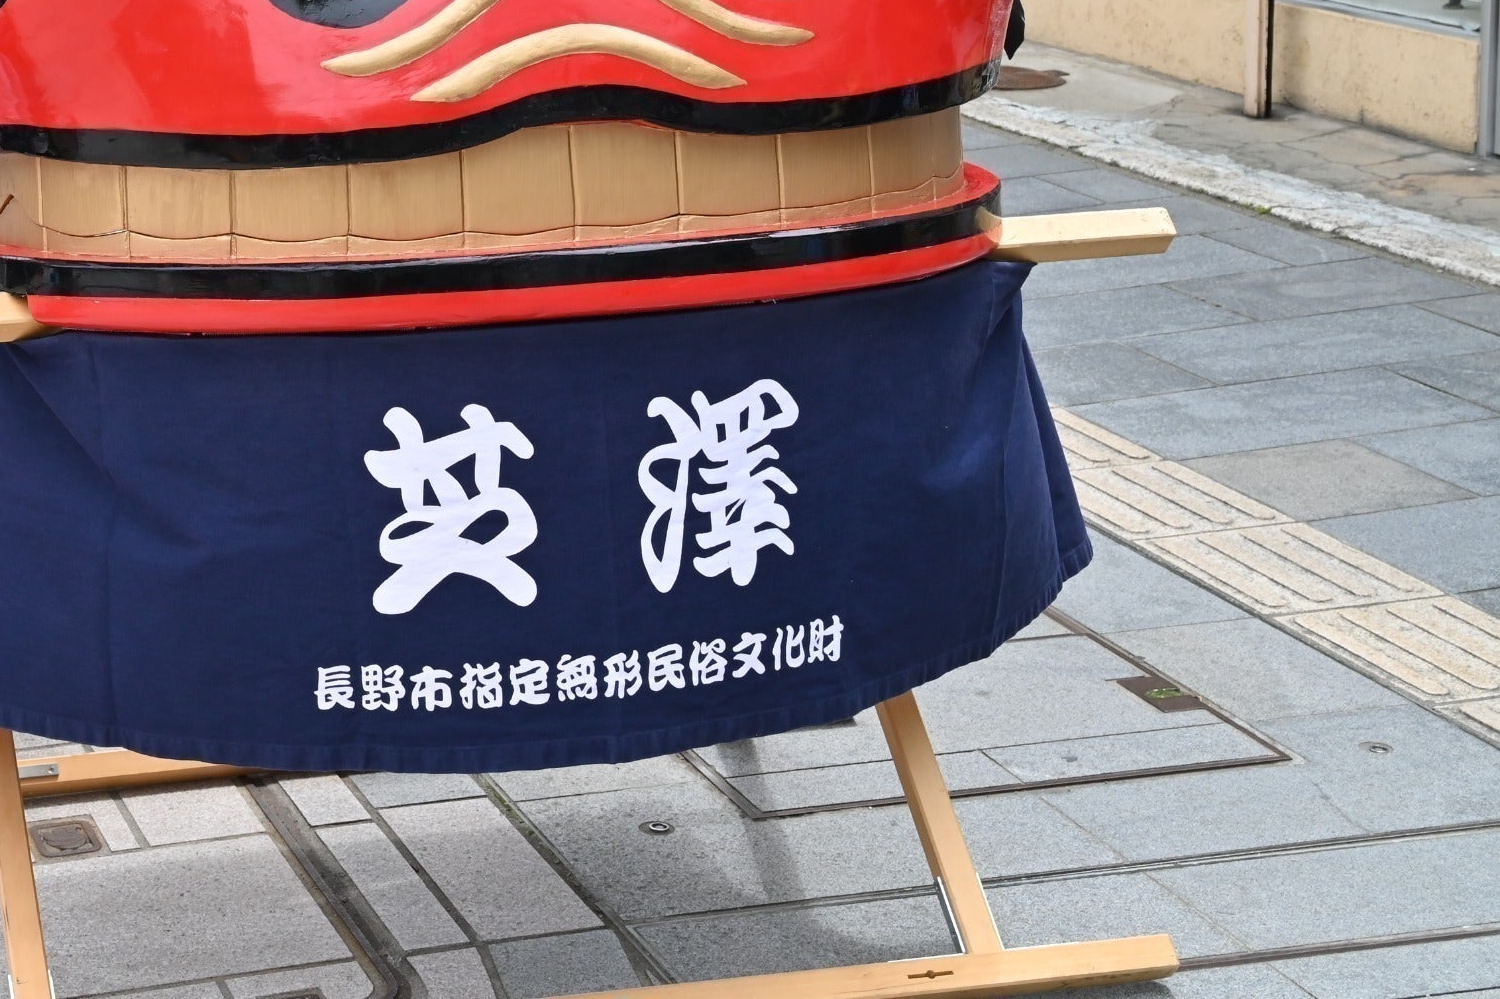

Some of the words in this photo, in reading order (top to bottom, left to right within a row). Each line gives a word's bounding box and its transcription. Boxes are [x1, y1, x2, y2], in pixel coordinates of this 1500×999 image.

[313, 614, 845, 712] 長野市指定無形民俗文化財
